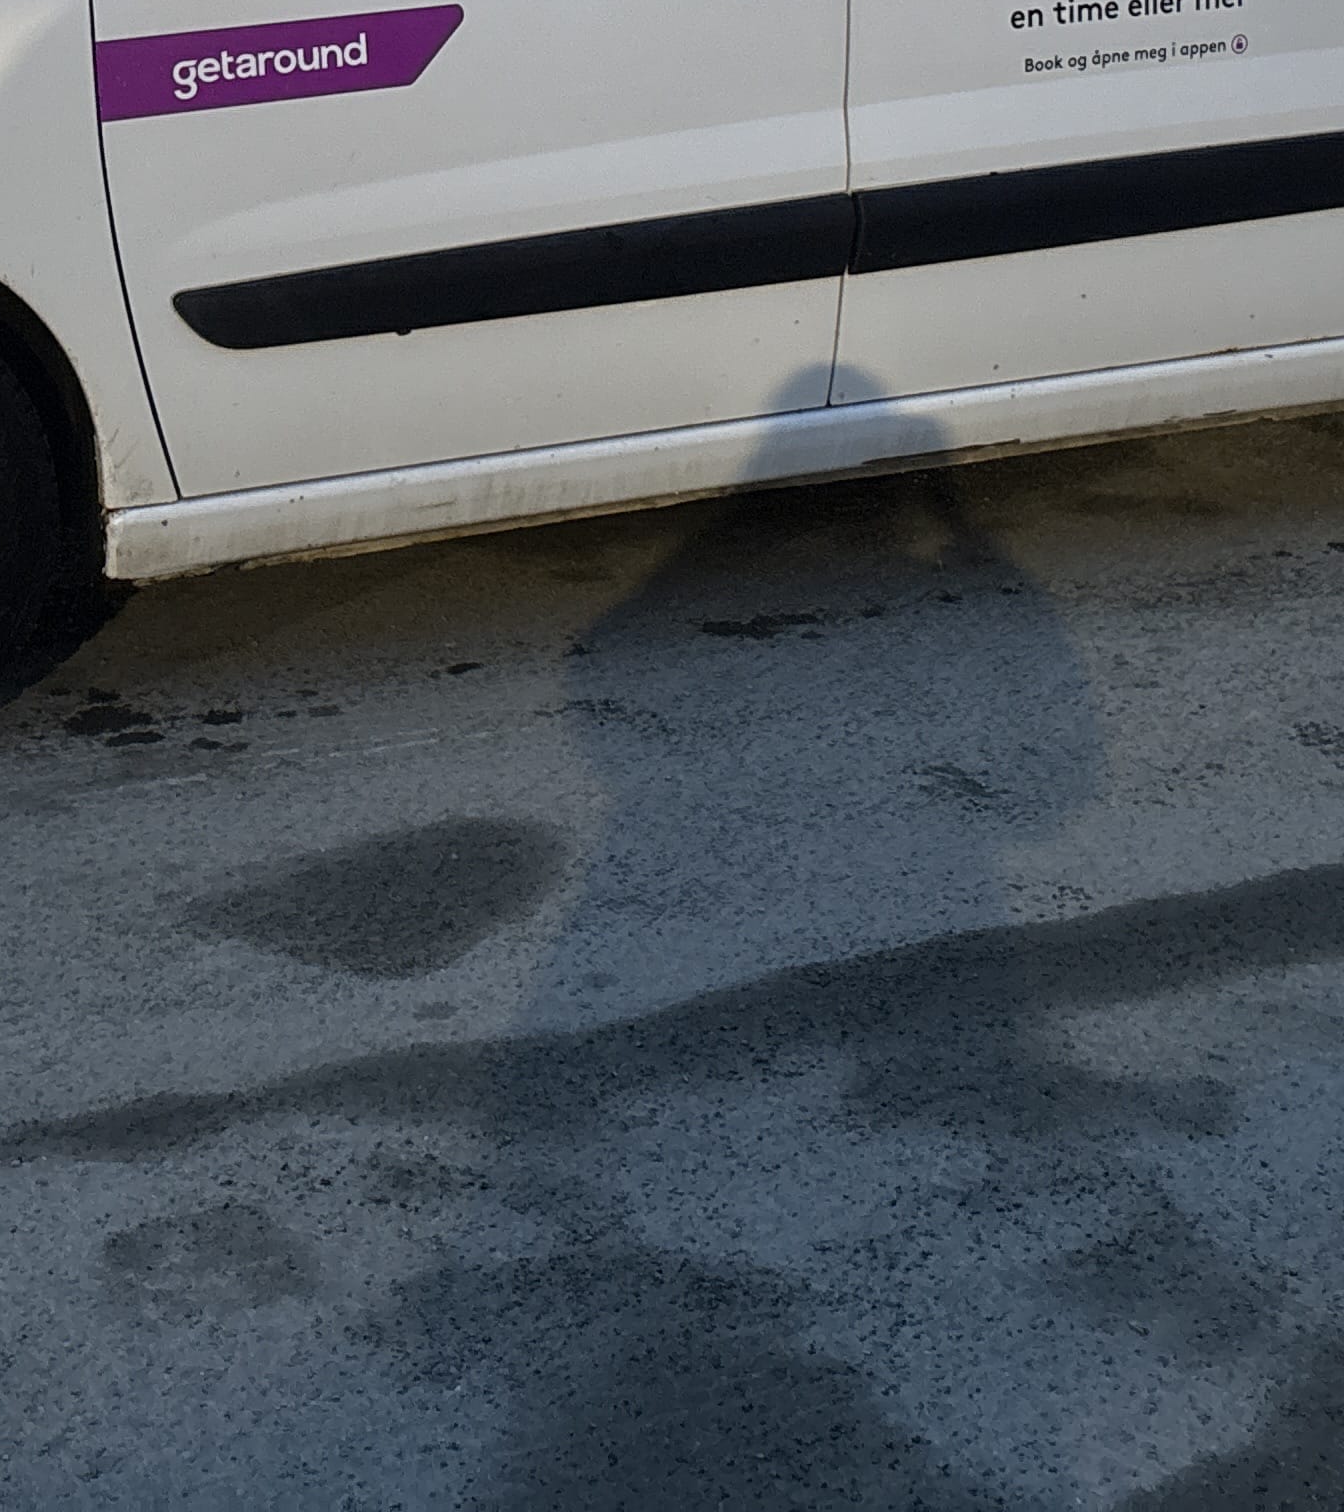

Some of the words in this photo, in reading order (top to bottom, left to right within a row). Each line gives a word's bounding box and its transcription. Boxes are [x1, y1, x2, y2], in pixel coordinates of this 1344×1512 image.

[1010, 8, 1044, 29] en
[172, 32, 368, 100] getaround
[1024, 55, 1064, 73] Book
[1067, 55, 1087, 71] og
[1091, 49, 1131, 69] åpne
[1134, 46, 1167, 63] meg
[1180, 40, 1226, 59] appen
